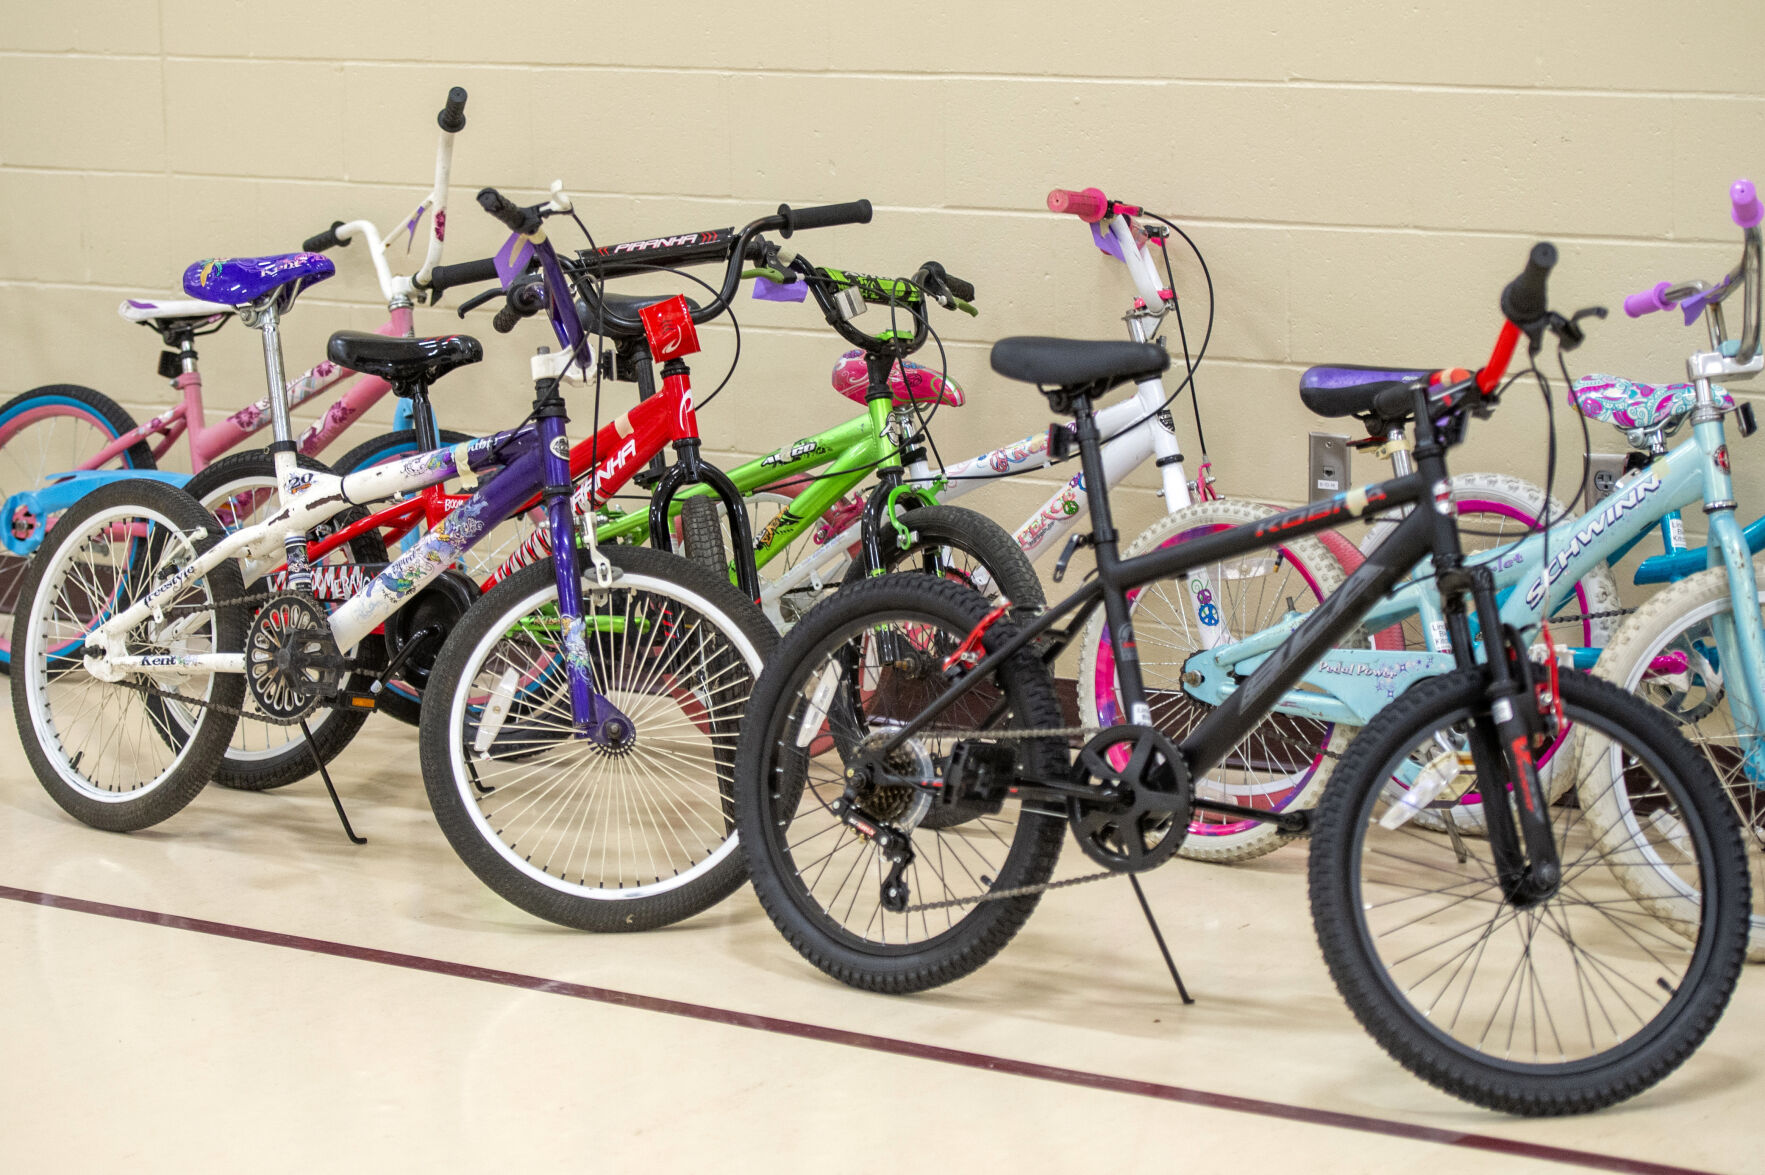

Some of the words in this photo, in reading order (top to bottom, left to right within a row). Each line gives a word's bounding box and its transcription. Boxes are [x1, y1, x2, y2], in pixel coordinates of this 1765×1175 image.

[613, 232, 699, 255] PIRANHA
[288, 472, 315, 490] 20
[1525, 473, 1662, 610] SCHWINN
[144, 565, 195, 609] freestyle
[140, 655, 177, 666] Kent
[1318, 660, 1354, 676] Pedal
[1356, 664, 1398, 680] Power
